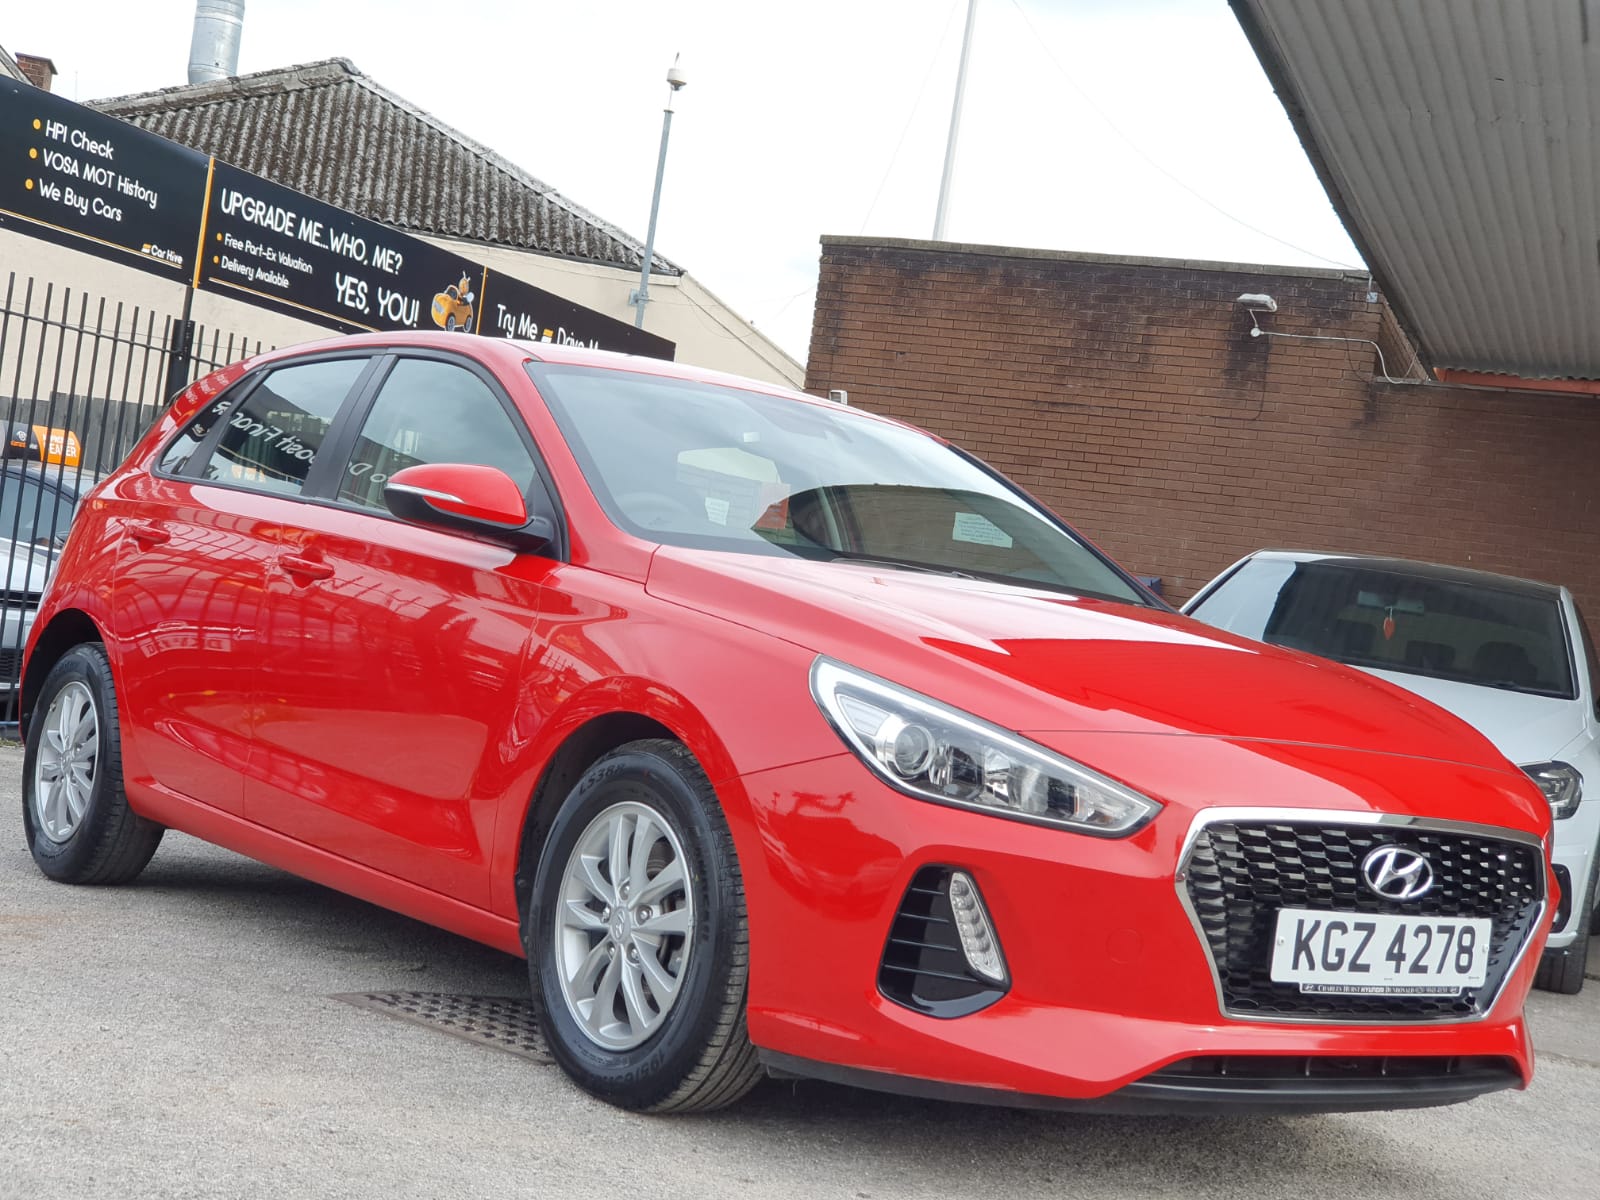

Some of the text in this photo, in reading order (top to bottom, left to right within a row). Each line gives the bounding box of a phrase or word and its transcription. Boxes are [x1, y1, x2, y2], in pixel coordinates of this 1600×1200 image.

[45, 119, 114, 160] HPI Check
[39, 178, 122, 222] We Buy Cars
[43, 148, 158, 210] VOSA MOT History
[220, 188, 297, 238] UPGRADE
[371, 245, 404, 276] ME?
[224, 232, 313, 274] Free Part-Ex Valuation
[151, 244, 183, 265] Car Hive
[221, 255, 290, 289] Delivery Available
[335, 271, 420, 328] YES, YOU!
[497, 303, 516, 339] Try
[518, 313, 538, 340] Me
[1291, 918, 1476, 975] KGZ 4278
